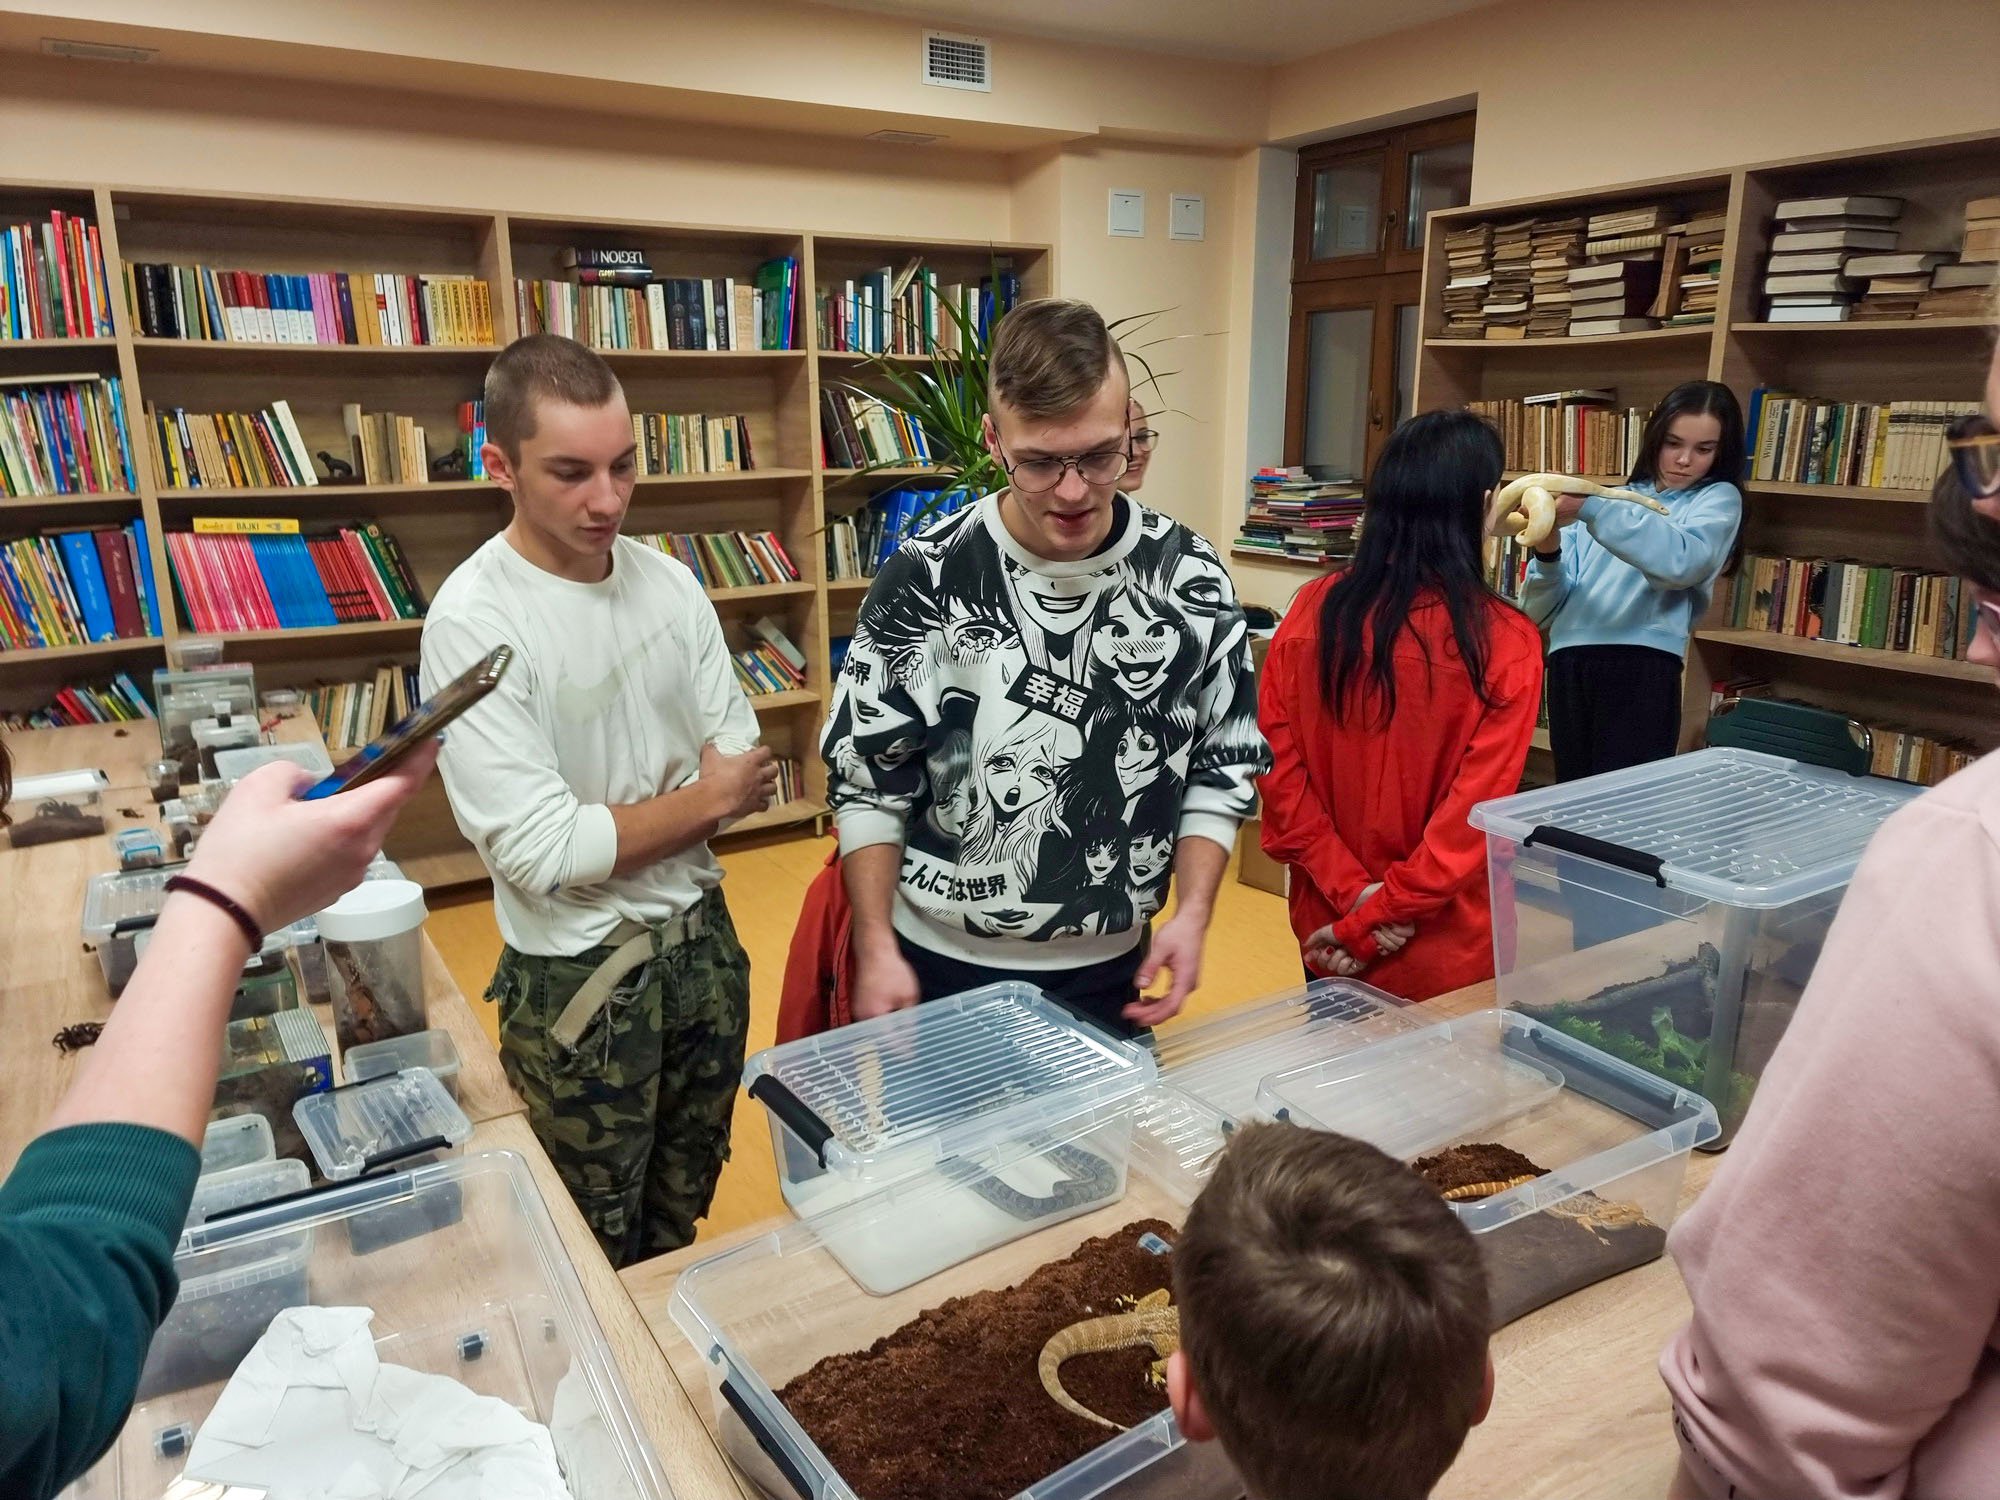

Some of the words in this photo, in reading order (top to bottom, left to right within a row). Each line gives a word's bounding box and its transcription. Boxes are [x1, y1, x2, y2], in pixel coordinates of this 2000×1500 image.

[600, 250, 644, 264] LEGION
[718, 319, 726, 345] HARDA
[236, 522, 260, 530] BAJKI
[1023, 672, 1088, 720] 幸福
